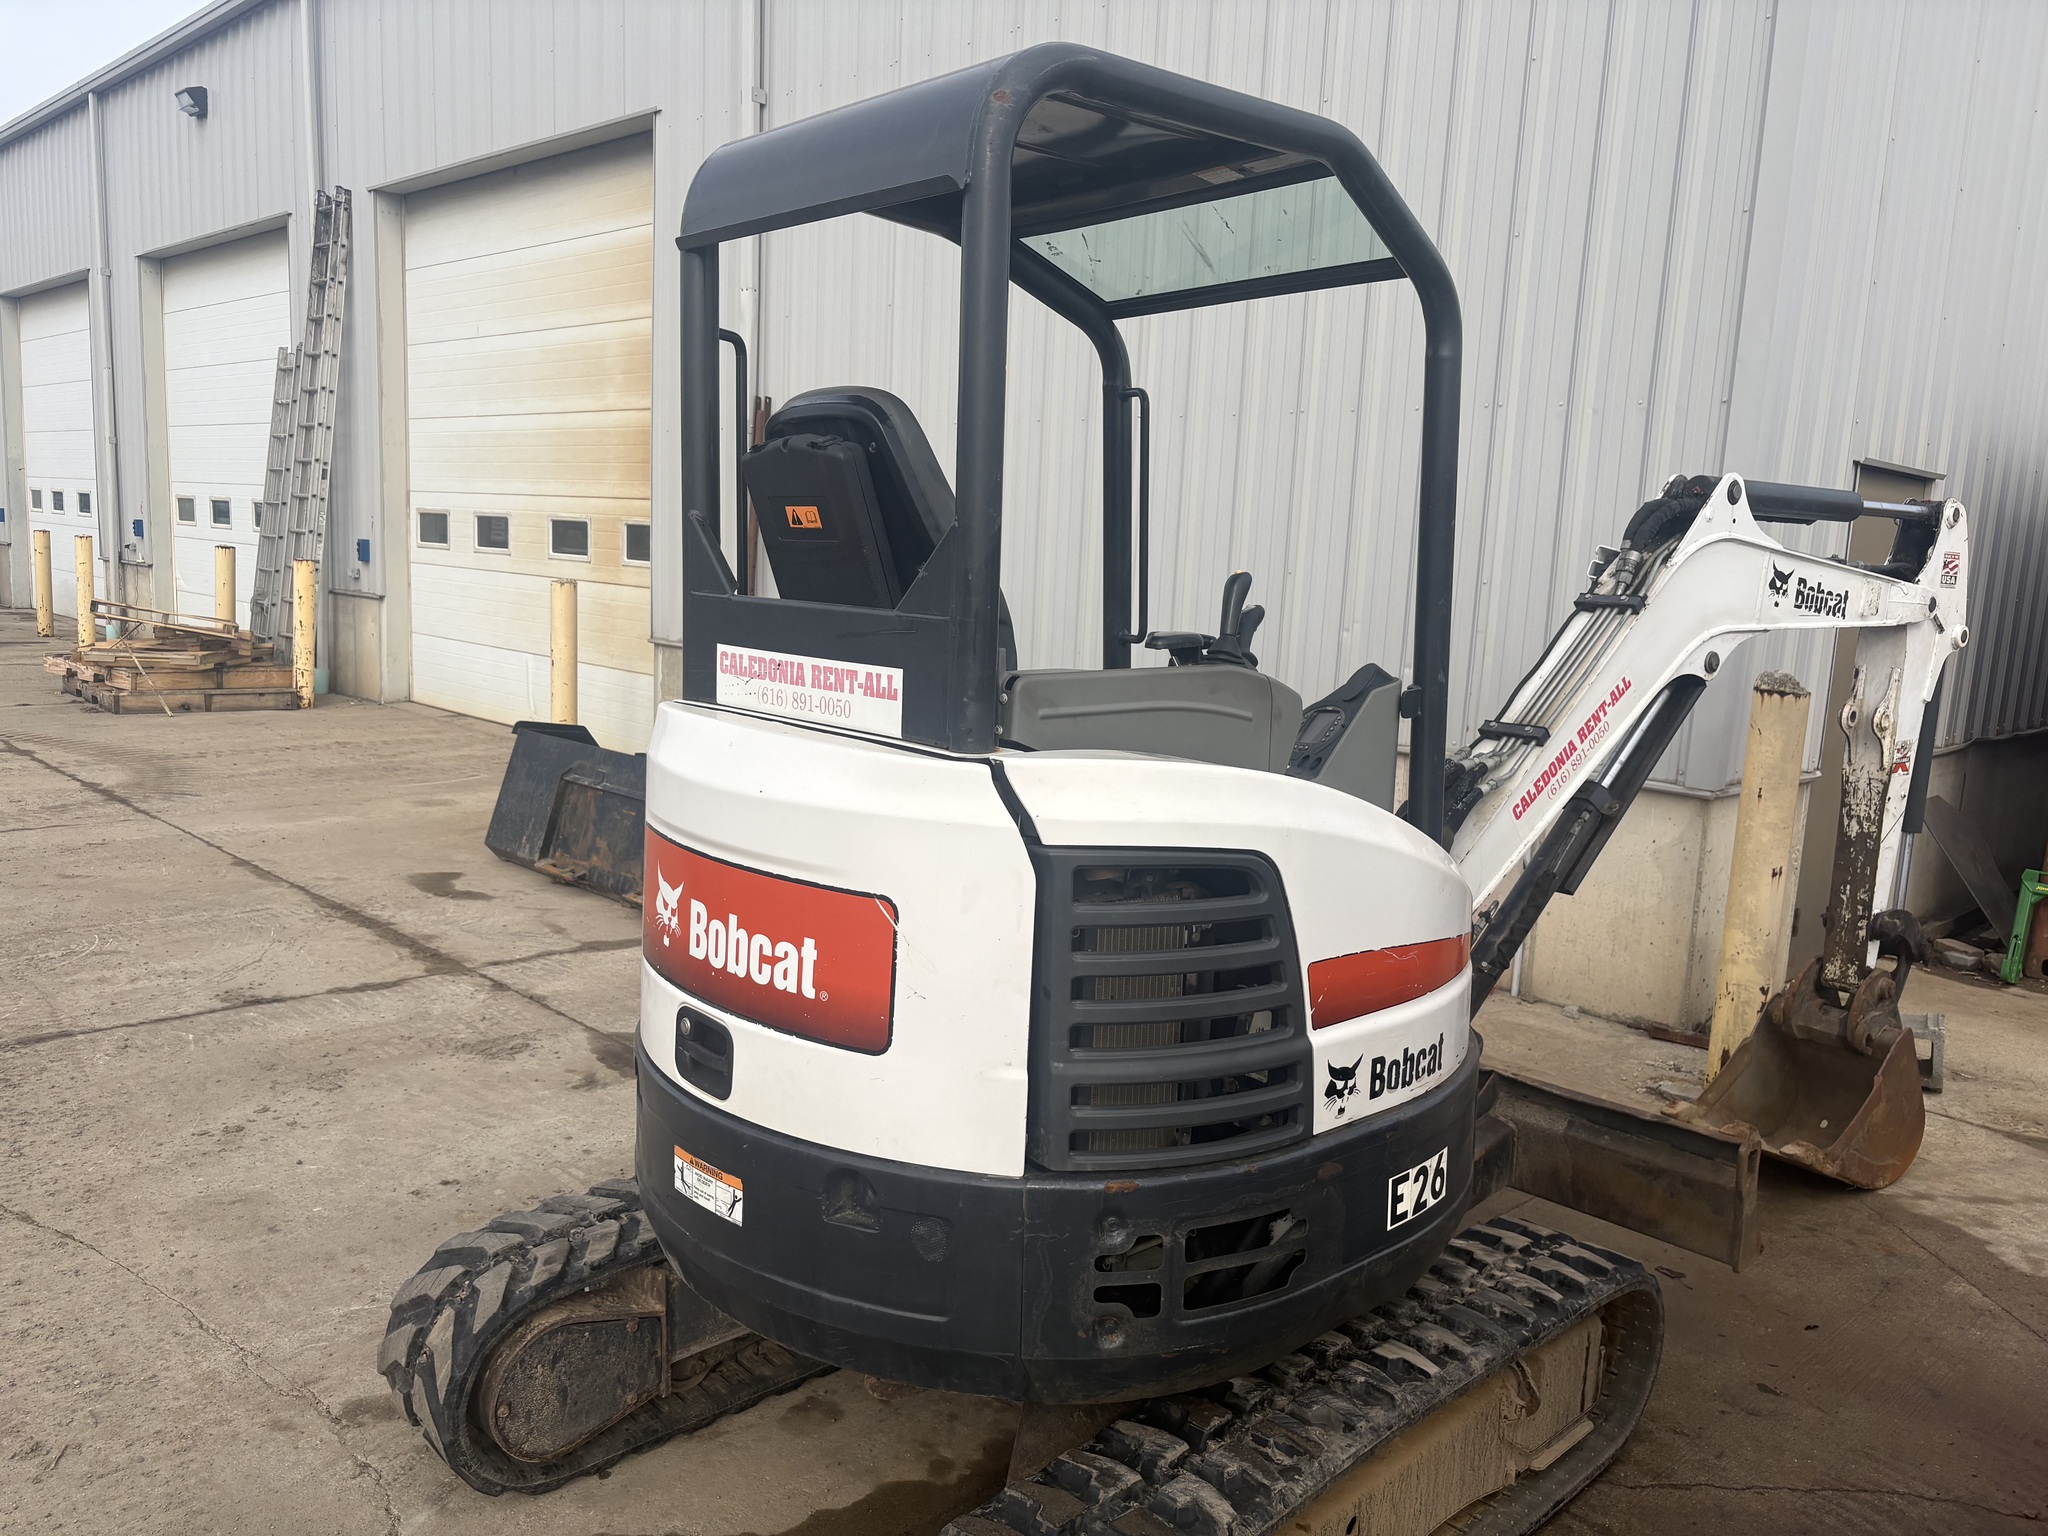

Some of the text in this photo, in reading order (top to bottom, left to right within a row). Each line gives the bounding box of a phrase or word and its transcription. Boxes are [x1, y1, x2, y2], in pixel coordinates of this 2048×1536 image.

[1794, 577, 1849, 620] Bobcat
[1941, 575, 1957, 585] USA
[719, 650, 898, 702] CALEDONIA RENT-ALL
[757, 685, 852, 719] (616) 891-0050
[1512, 676, 1632, 821] CALEDONIA RENT-ALL
[1546, 721, 1610, 800] (616) 891-0050
[689, 898, 818, 1000] Bobcat
[1369, 1032, 1444, 1100] Bobcat
[694, 1158, 723, 1181] WARNING
[1389, 1151, 1445, 1227] E26
